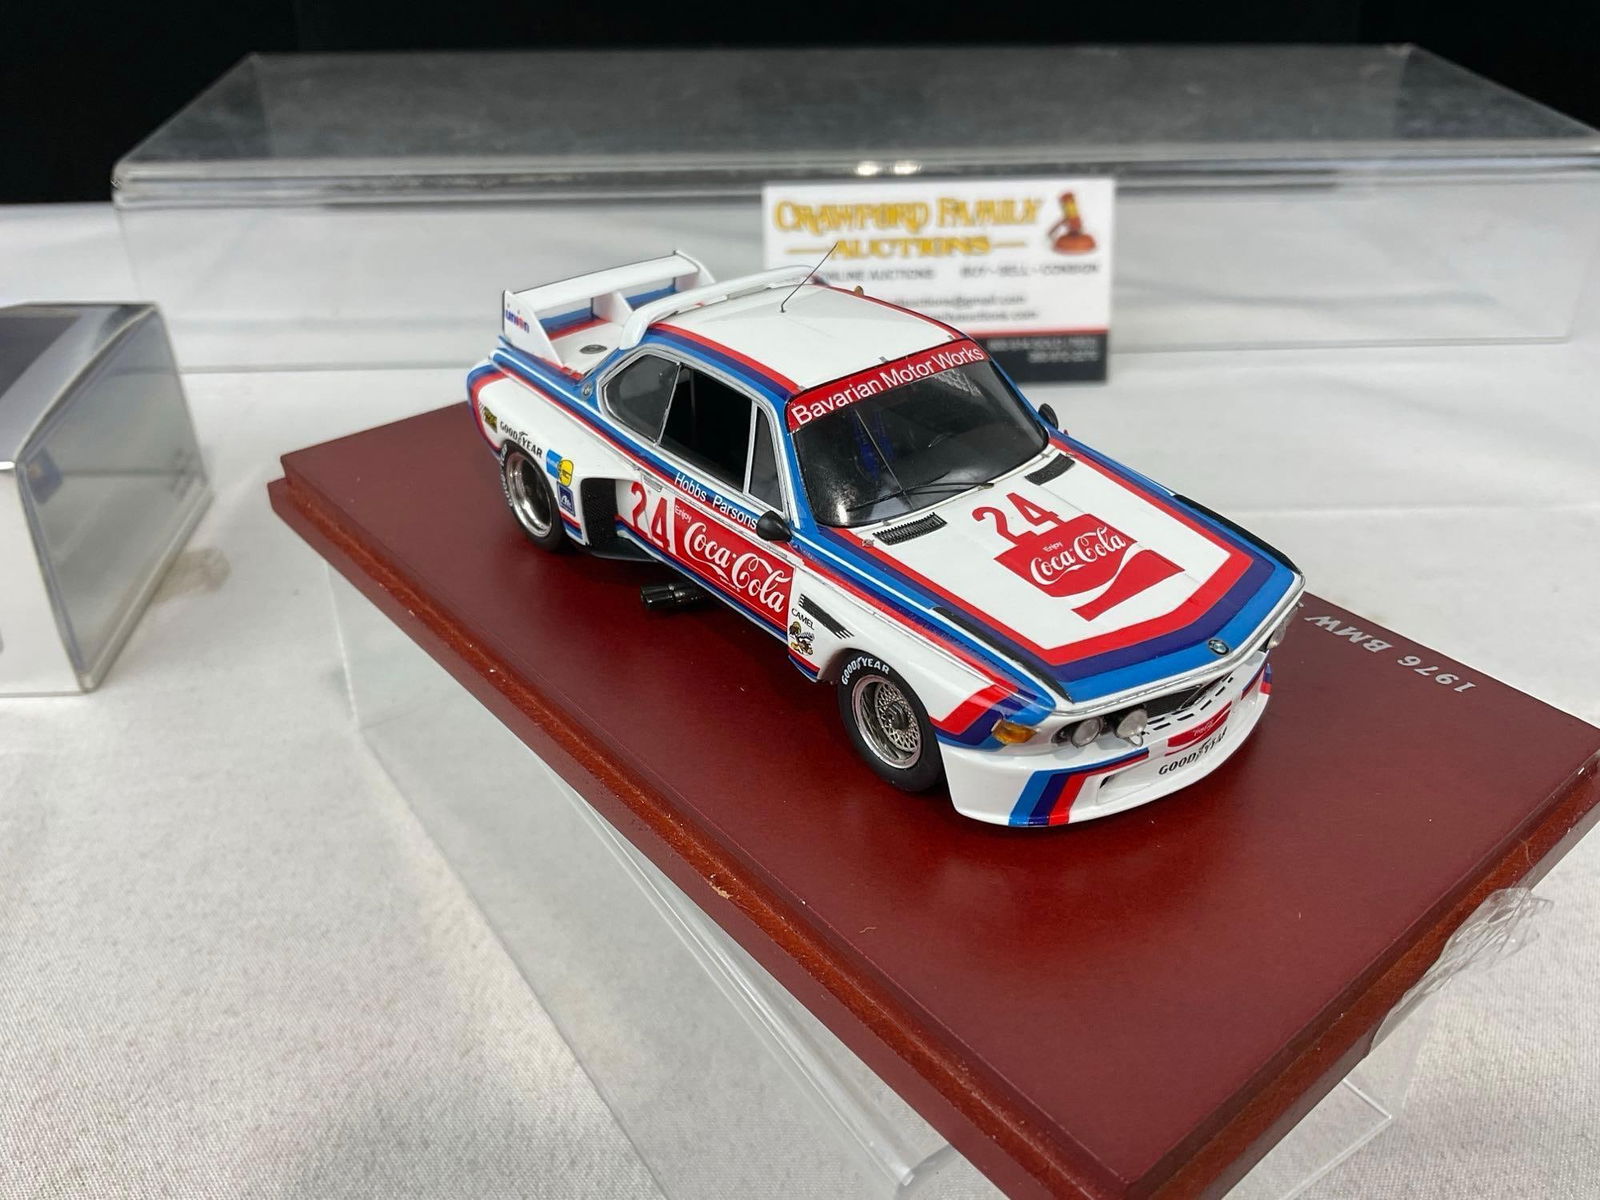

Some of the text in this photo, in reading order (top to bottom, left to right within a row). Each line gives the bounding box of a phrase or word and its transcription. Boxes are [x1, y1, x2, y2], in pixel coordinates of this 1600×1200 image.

[936, 197, 1042, 227] FAMILY
[831, 235, 993, 259] AUCTIONS
[791, 346, 985, 425] Bavarian Motor Works
[500, 421, 543, 459] GOODYEAR
[631, 481, 671, 551] 24
[674, 472, 757, 531] Hobbs Parsons
[674, 505, 692, 524] Enjoy
[972, 492, 1066, 545] 24
[684, 521, 791, 613] Coca-Cola
[1030, 526, 1126, 585] Coca-Cola
[791, 608, 815, 631] CAMEL
[841, 655, 890, 686] GOODYEAR
[1304, 615, 1476, 693] 1976 BMW
